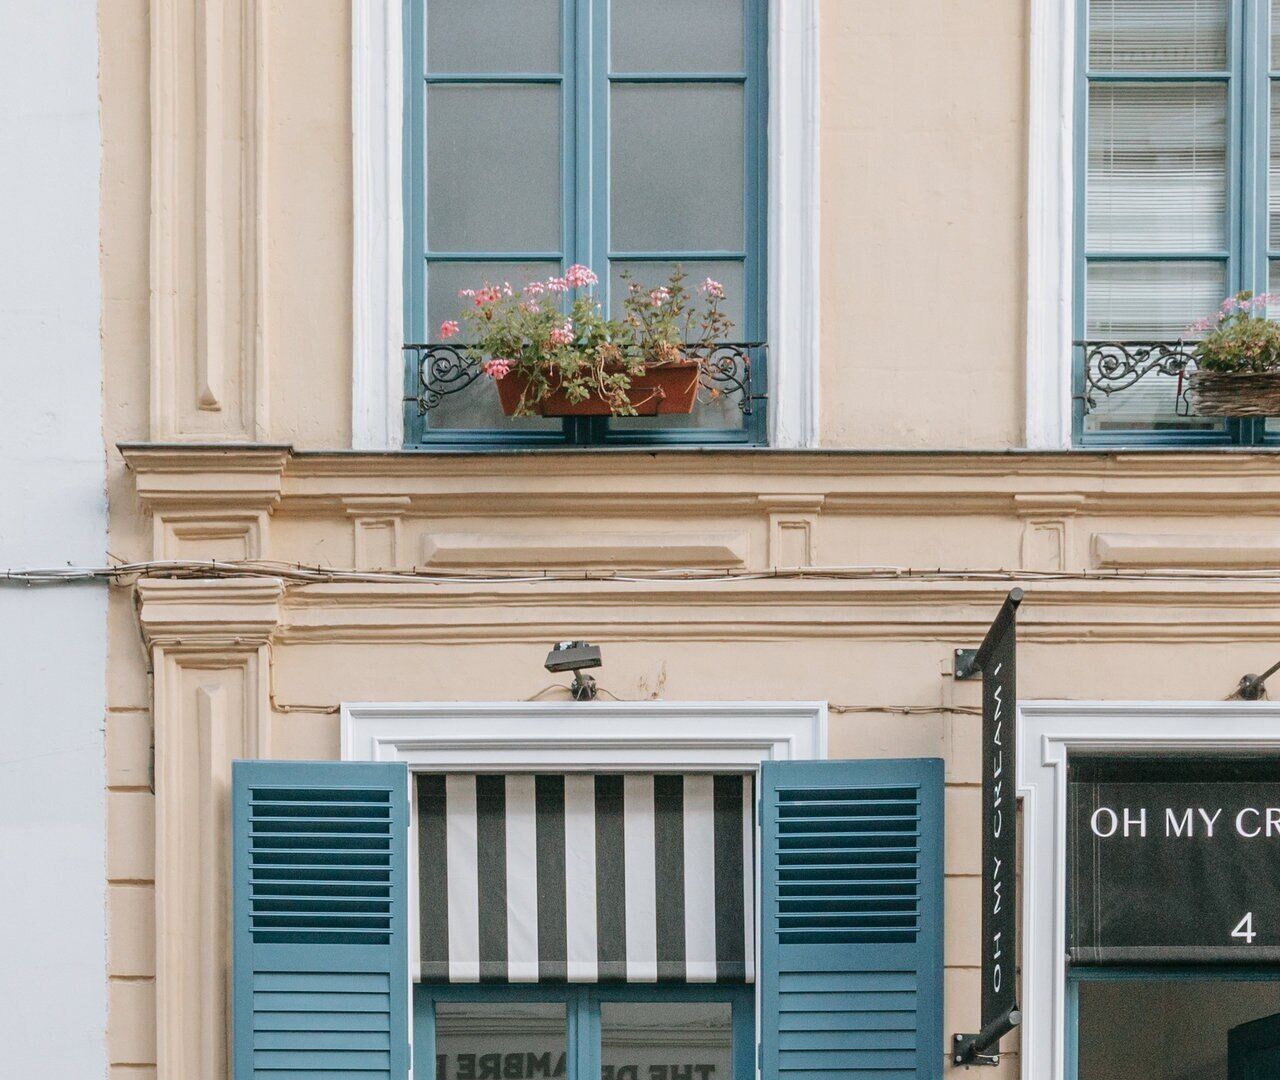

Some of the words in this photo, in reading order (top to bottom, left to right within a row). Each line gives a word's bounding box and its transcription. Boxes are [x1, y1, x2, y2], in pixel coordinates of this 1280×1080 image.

[993, 685, 1002, 838] CREAM
[1090, 807, 1147, 838] OH
[1165, 807, 1222, 838] MY
[993, 856, 1002, 914] MY
[1231, 911, 1257, 943] 4
[993, 932, 1002, 993] OH
